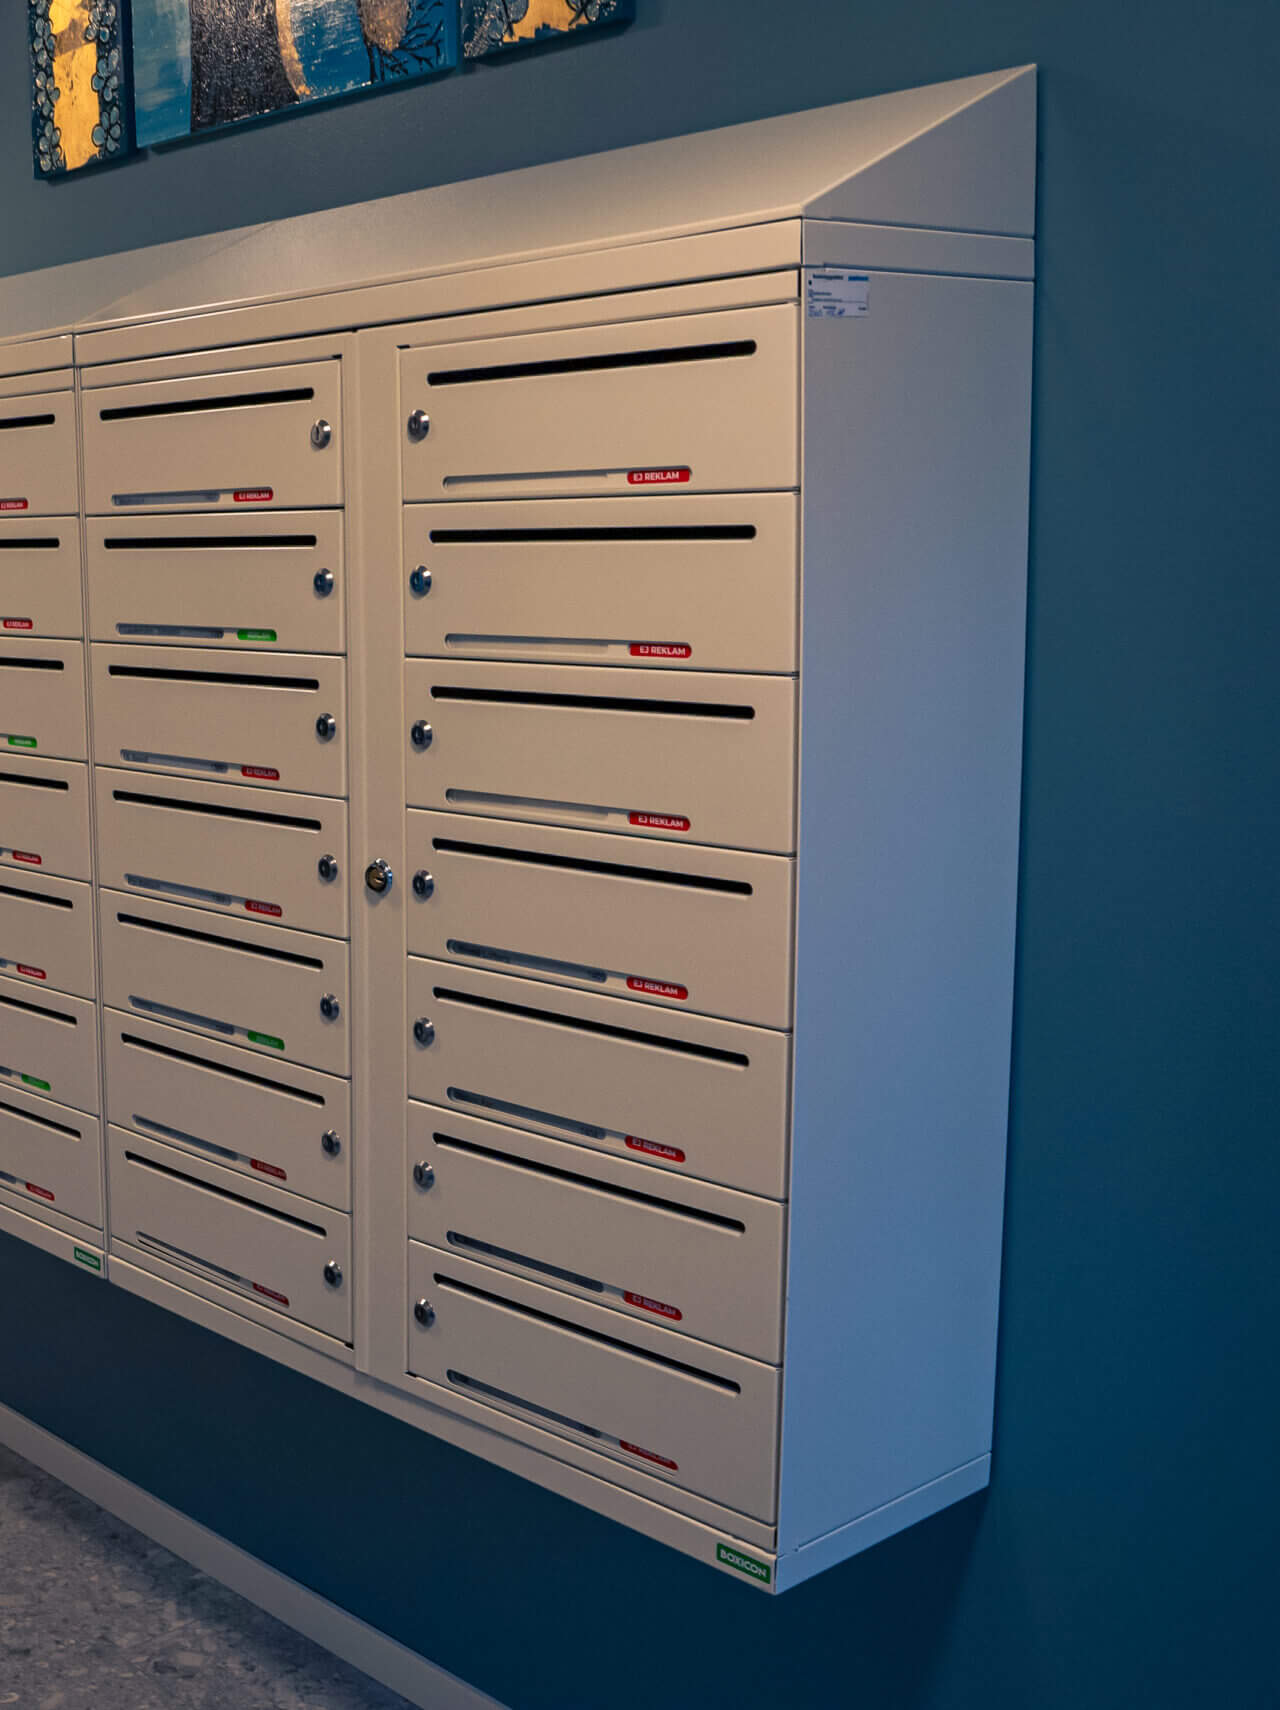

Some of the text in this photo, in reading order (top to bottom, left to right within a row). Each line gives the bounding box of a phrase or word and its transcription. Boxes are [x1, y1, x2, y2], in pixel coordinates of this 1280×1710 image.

[645, 471, 680, 481] REKLAM
[651, 646, 686, 656] REKLAM
[649, 816, 684, 828] REKLAM
[644, 981, 678, 995] REKLAM
